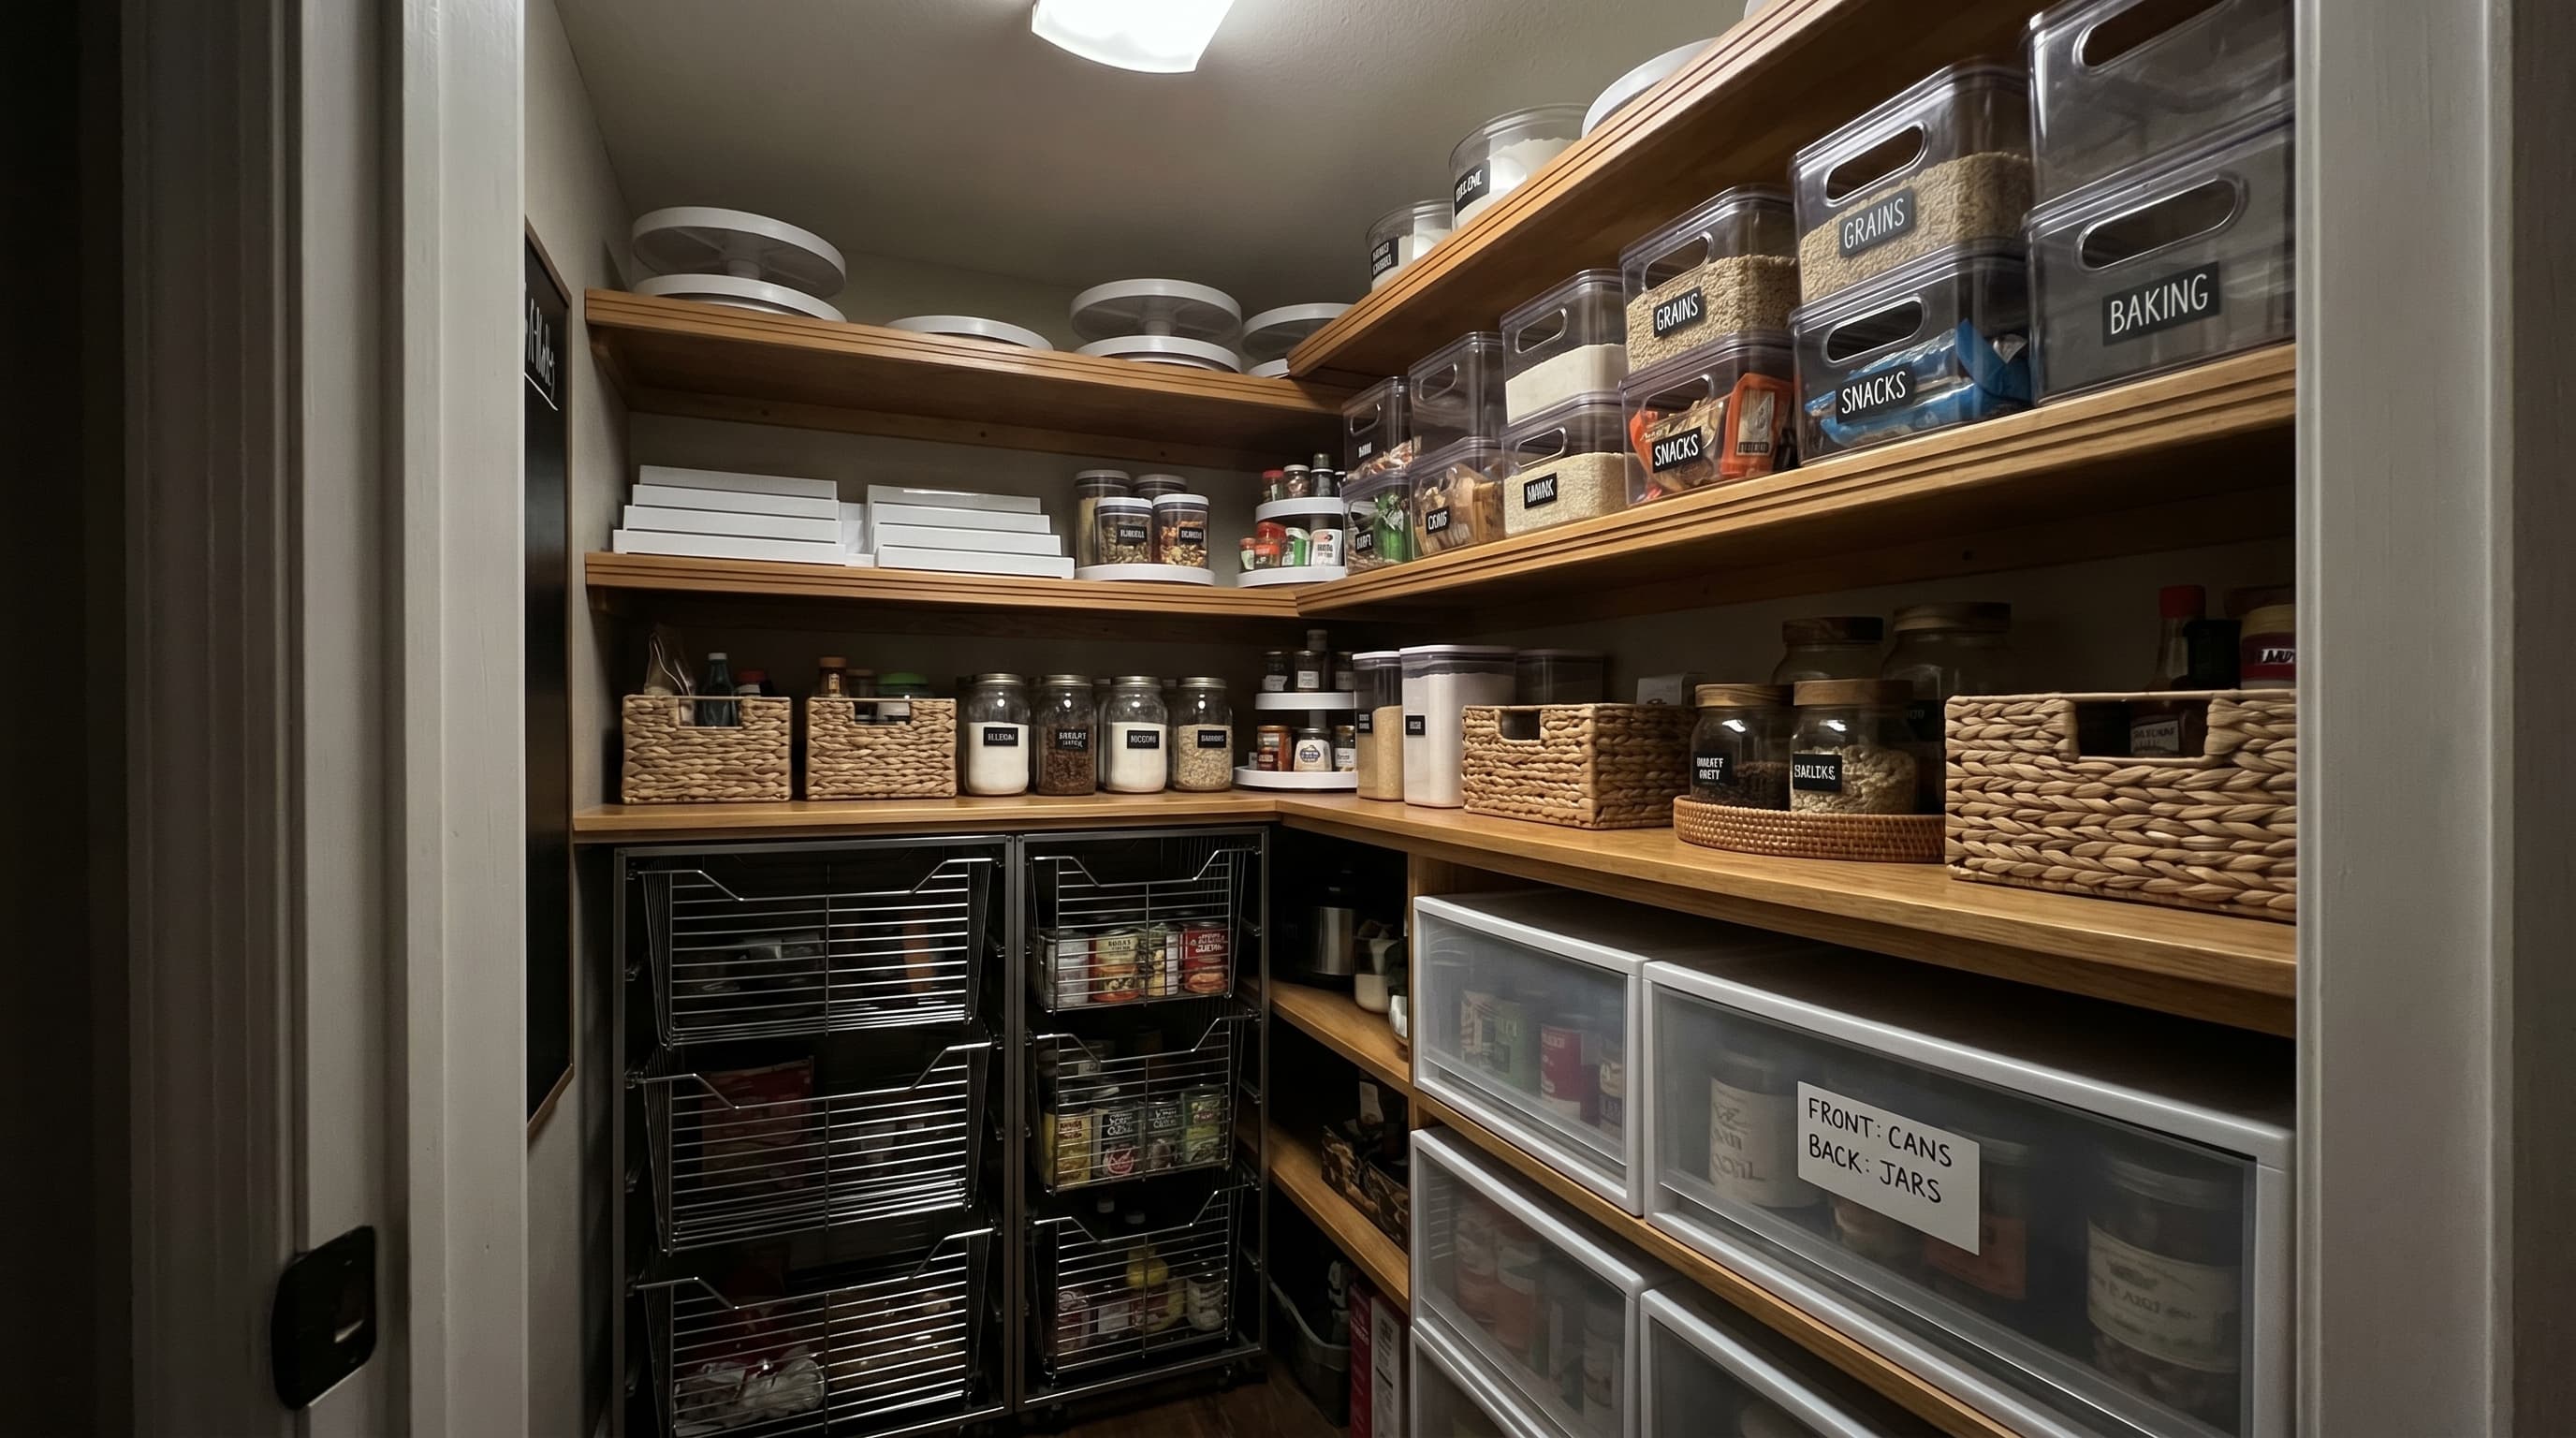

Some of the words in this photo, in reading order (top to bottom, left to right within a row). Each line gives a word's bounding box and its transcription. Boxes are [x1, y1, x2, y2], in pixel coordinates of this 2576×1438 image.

[1843, 198, 1906, 249] GRAINS
[1656, 292, 1699, 331] GRAINS
[2110, 273, 2209, 336] BAKING
[1840, 370, 1907, 415] SNACKS
[1654, 433, 1699, 467] SNACKS
[1808, 1097, 1881, 1138] FRONT:
[1888, 1125, 1953, 1167] CANS
[1808, 1134, 1870, 1175] BACK:
[1879, 1159, 1942, 1204] JARS
